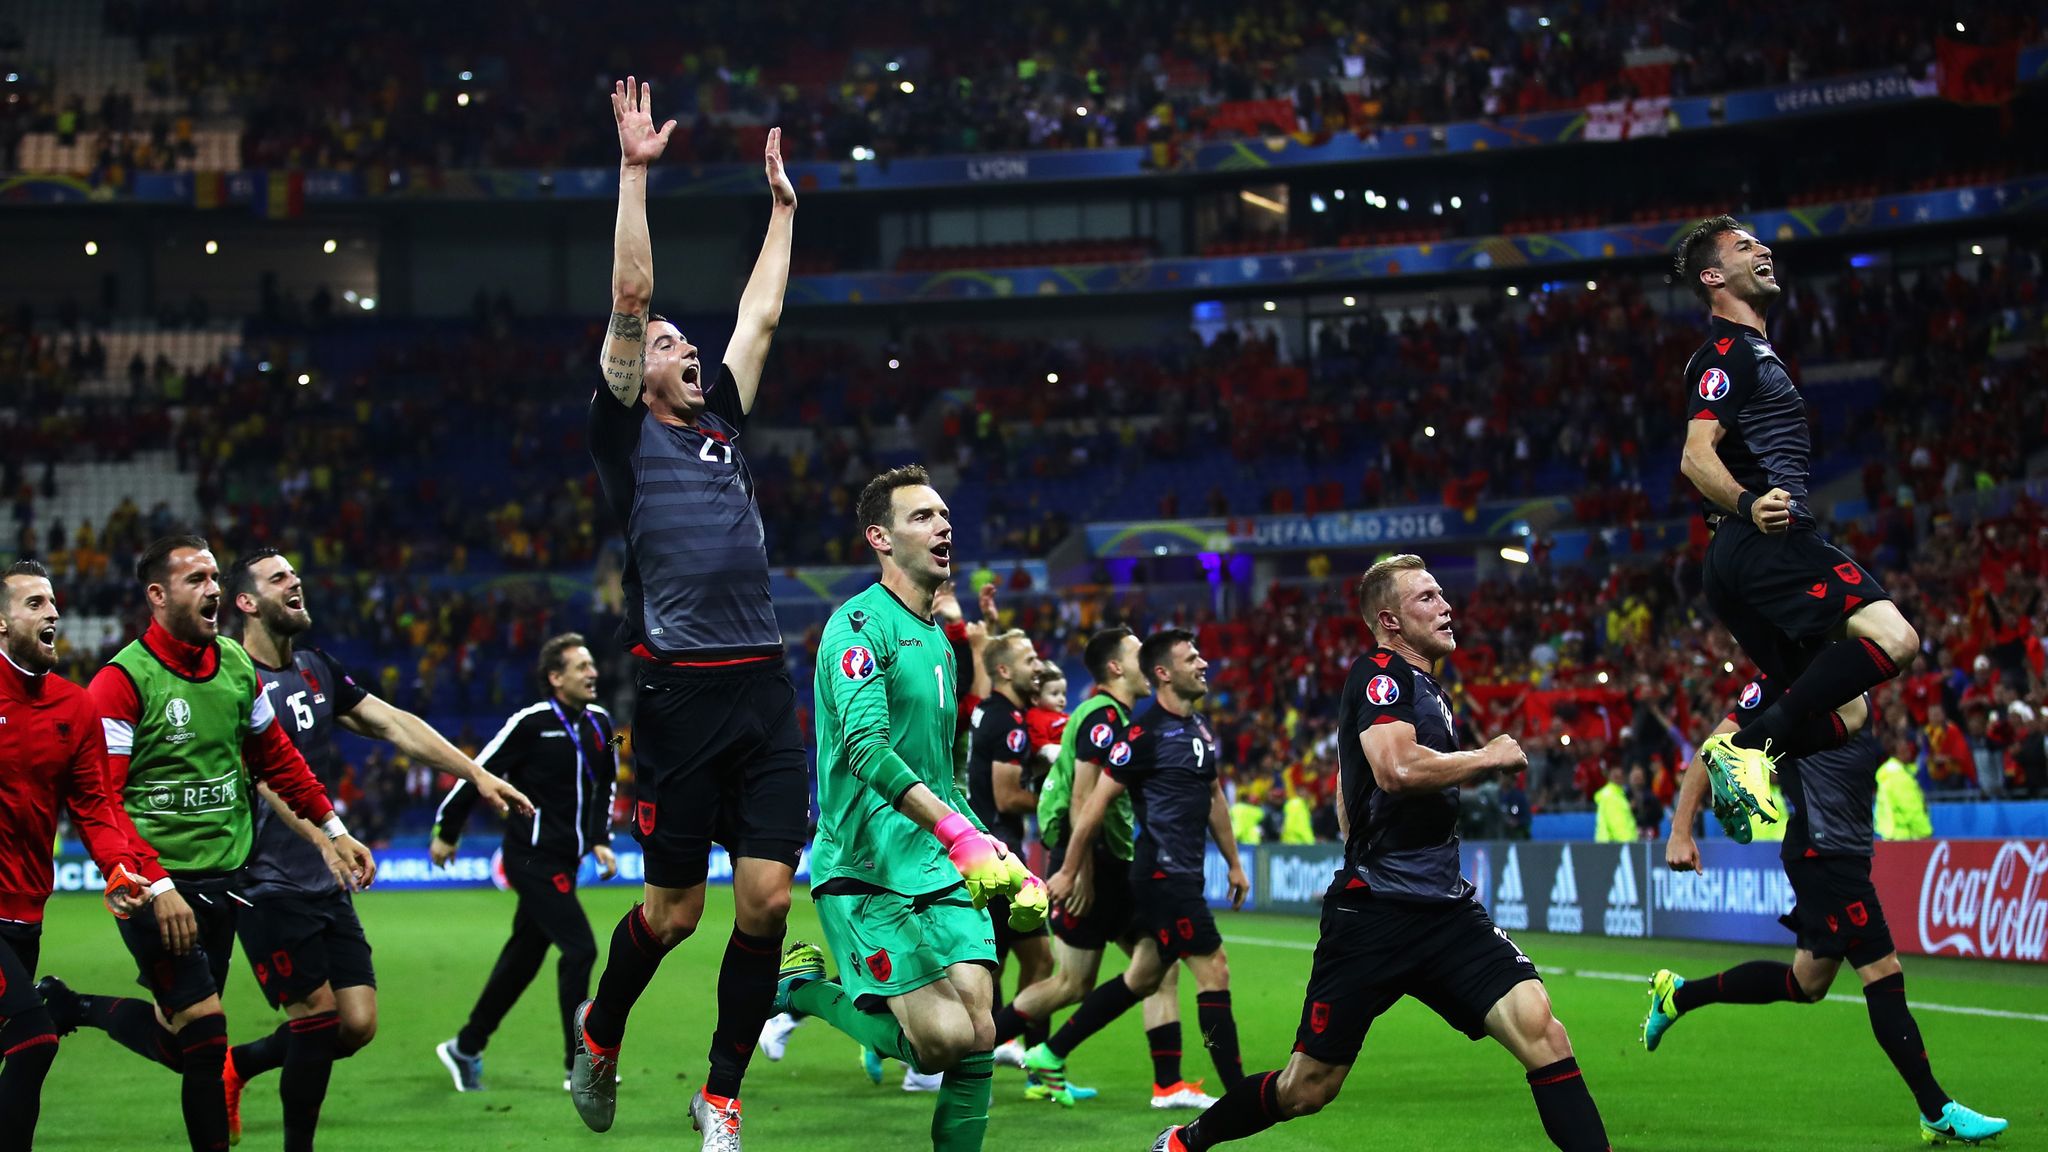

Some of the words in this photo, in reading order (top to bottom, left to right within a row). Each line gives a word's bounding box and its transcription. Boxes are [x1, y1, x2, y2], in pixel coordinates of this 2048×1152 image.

[1775, 89, 1821, 111] UEFA
[1824, 80, 1871, 104] EURO
[967, 159, 1027, 180] LYON
[1255, 522, 1313, 545] UEFA
[1317, 516, 1381, 543] EURO
[1386, 513, 1444, 538] 2016
[934, 664, 944, 708] 1
[286, 690, 315, 732] 15
[1193, 738, 1204, 767] 9
[1652, 867, 1725, 912] TURKISH
[1918, 840, 2048, 959] Coca-Cola
